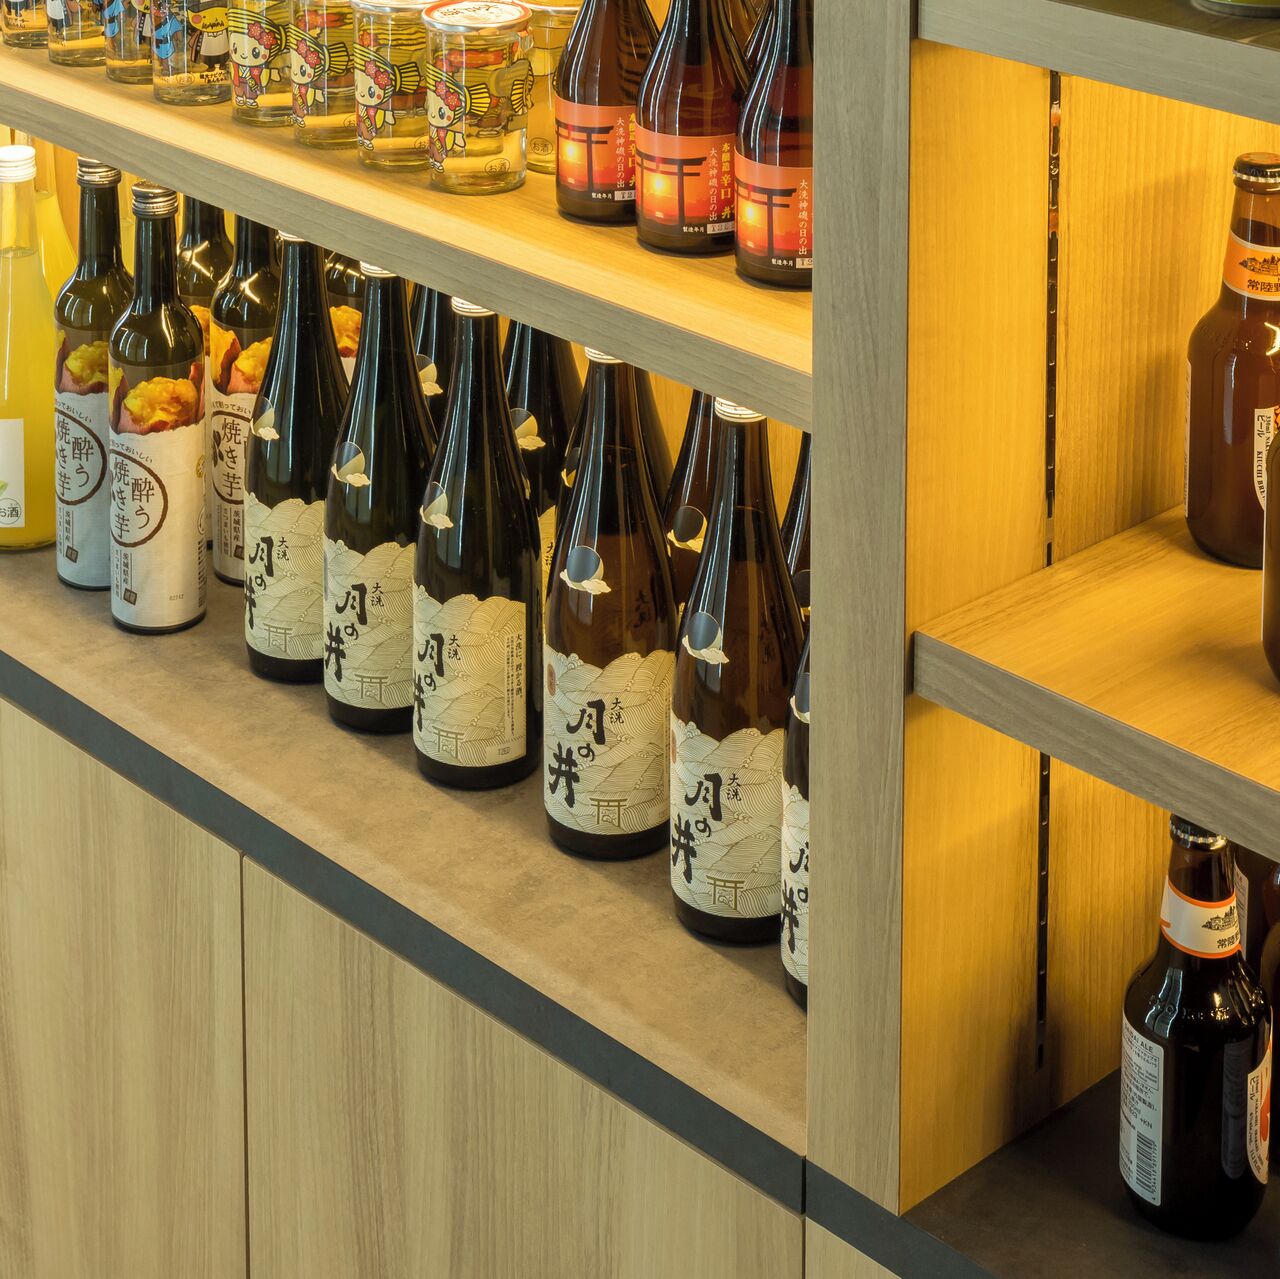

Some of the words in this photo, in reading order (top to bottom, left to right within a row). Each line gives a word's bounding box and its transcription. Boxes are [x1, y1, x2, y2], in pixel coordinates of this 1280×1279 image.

[615, 117, 625, 188] 大洗神磯の日の出
[708, 147, 719, 222] 大洗神磯の日の出
[721, 173, 732, 199] 辛口
[798, 179, 809, 256] 大洗神磯の日の出
[771, 258, 794, 267] 製造年月
[56, 400, 92, 424] っておいしい
[1257, 415, 1265, 438] ビール
[56, 417, 71, 497] 焼き芋
[72, 436, 94, 488] 酔う
[222, 417, 242, 498] 焼き芋
[113, 457, 130, 540] 焼き芋
[131, 477, 155, 529] 酔う
[277, 536, 290, 561] 大洗
[244, 536, 274, 629] 月の井
[371, 582, 384, 608] 大洗
[325, 583, 368, 683] 月の井
[448, 634, 461, 661] 大洗
[413, 633, 445, 732] 月の井
[609, 697, 624, 725] 大洗
[548, 699, 606, 808] 月の井
[726, 773, 742, 802] 大洗
[671, 773, 723, 884] 月の井
